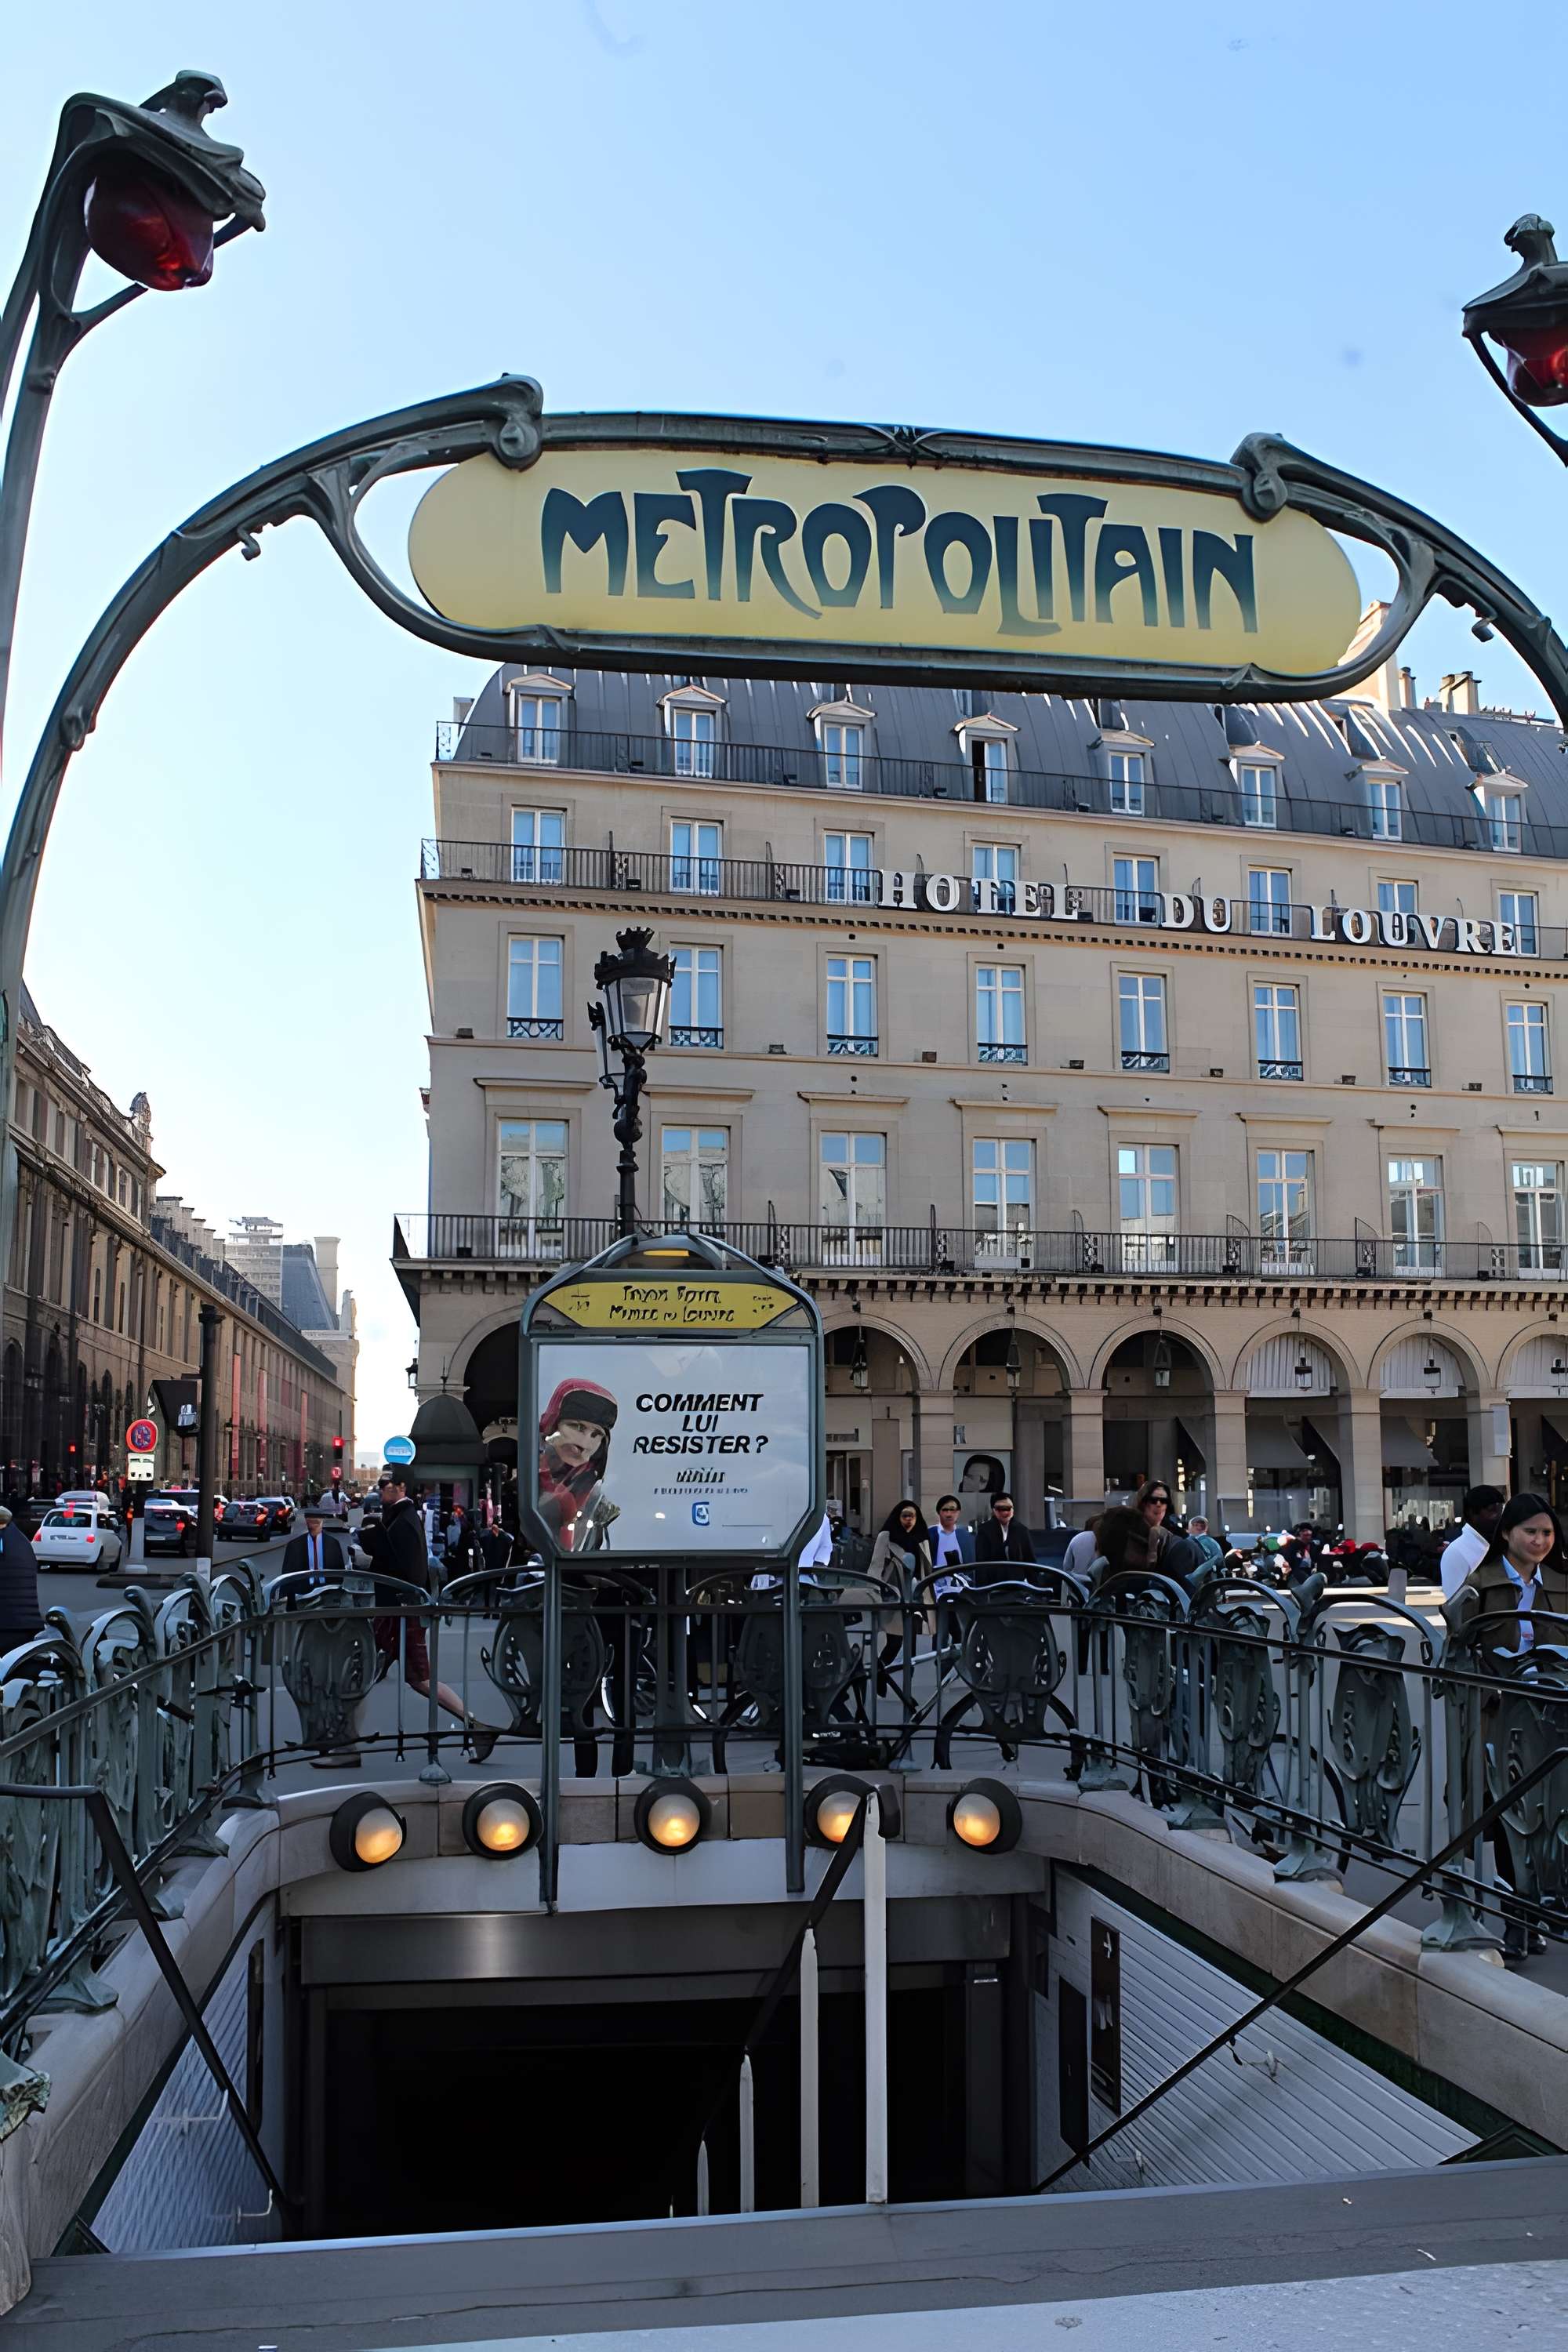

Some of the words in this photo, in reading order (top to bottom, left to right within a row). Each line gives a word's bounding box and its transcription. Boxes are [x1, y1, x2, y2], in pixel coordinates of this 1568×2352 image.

[541, 468, 1258, 637] METROPOLITAIN
[877, 869, 1079, 920] HOTEL
[1161, 891, 1232, 934] DU
[1311, 905, 1516, 955] LOUVRE
[636, 1393, 764, 1412] COMMENT
[682, 1414, 719, 1432] LUI
